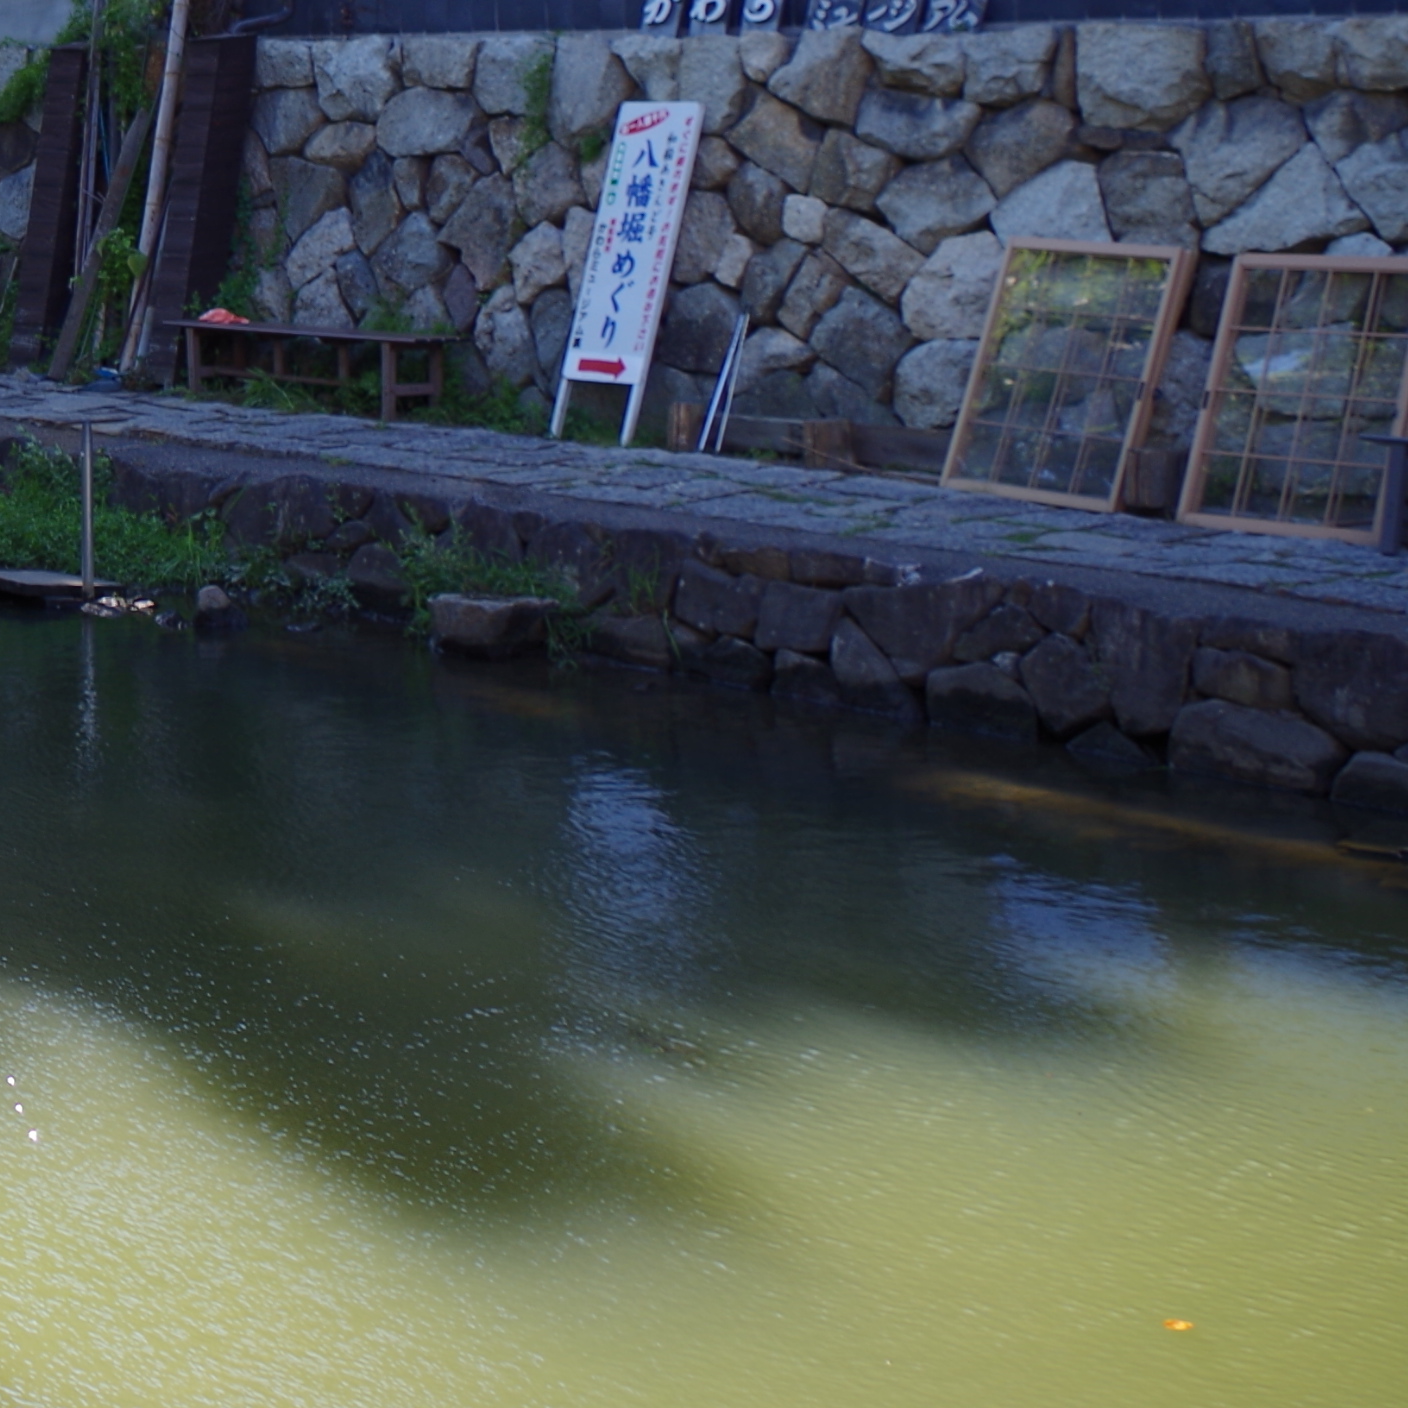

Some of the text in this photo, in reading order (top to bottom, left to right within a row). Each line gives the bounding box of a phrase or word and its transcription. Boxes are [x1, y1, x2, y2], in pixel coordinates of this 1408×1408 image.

[600, 138, 659, 349] 八幡堀めぐり
